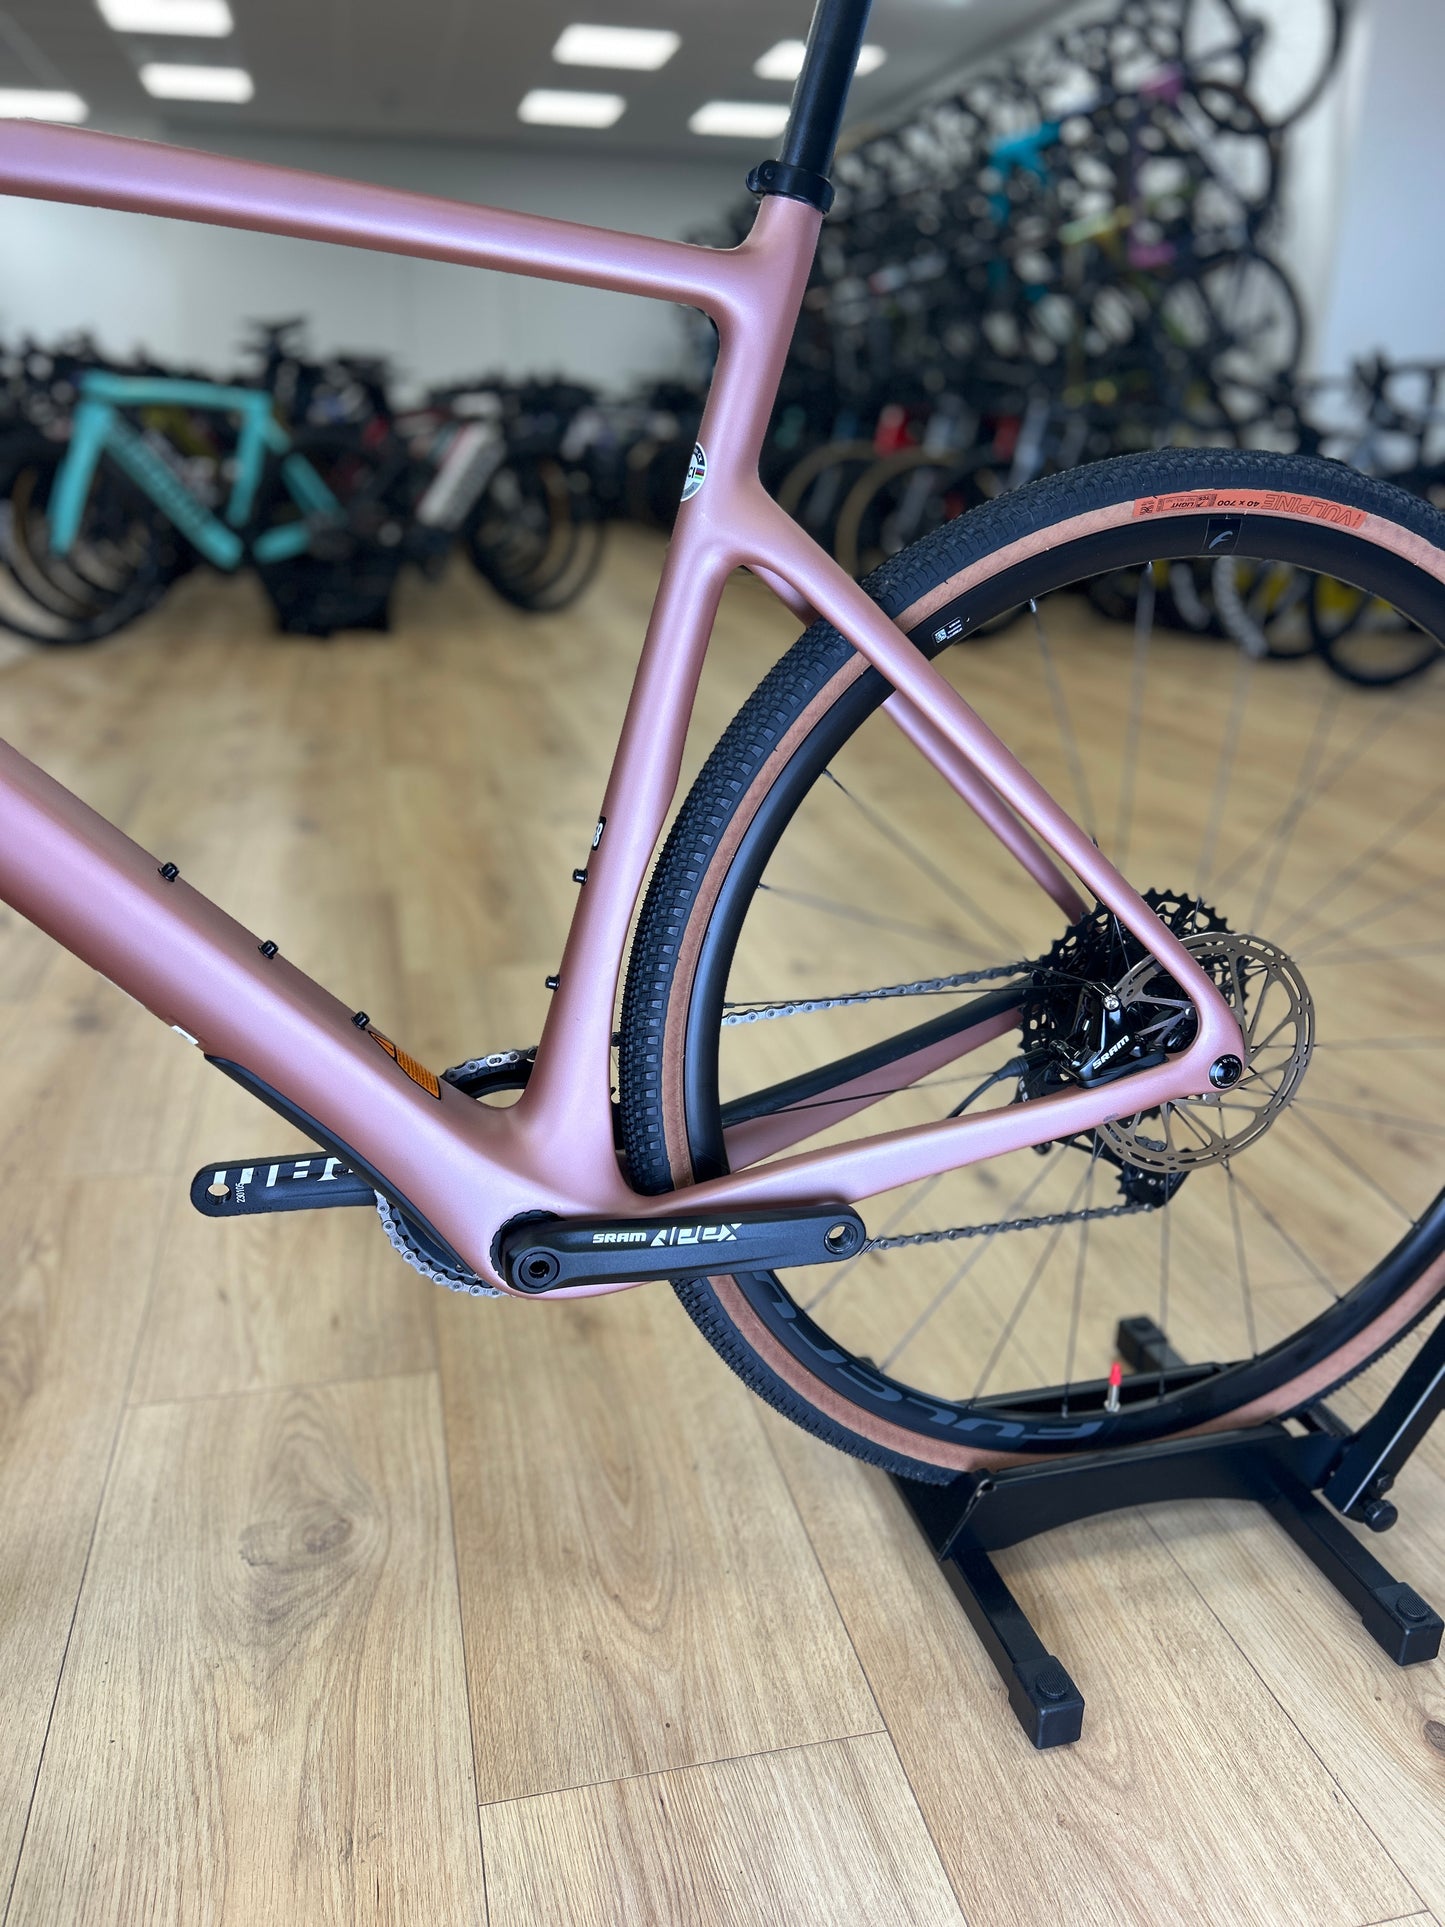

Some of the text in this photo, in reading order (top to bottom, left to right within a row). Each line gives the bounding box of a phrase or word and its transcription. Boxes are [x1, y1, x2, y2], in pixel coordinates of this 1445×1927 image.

[1170, 501, 1195, 509] LIGHT
[1247, 500, 1260, 508] 40
[1261, 494, 1352, 526] VULPINE
[1092, 1035, 1130, 1070] SRAM
[592, 1232, 647, 1244] SRAM
[752, 1270, 1104, 1440] FULCRU
